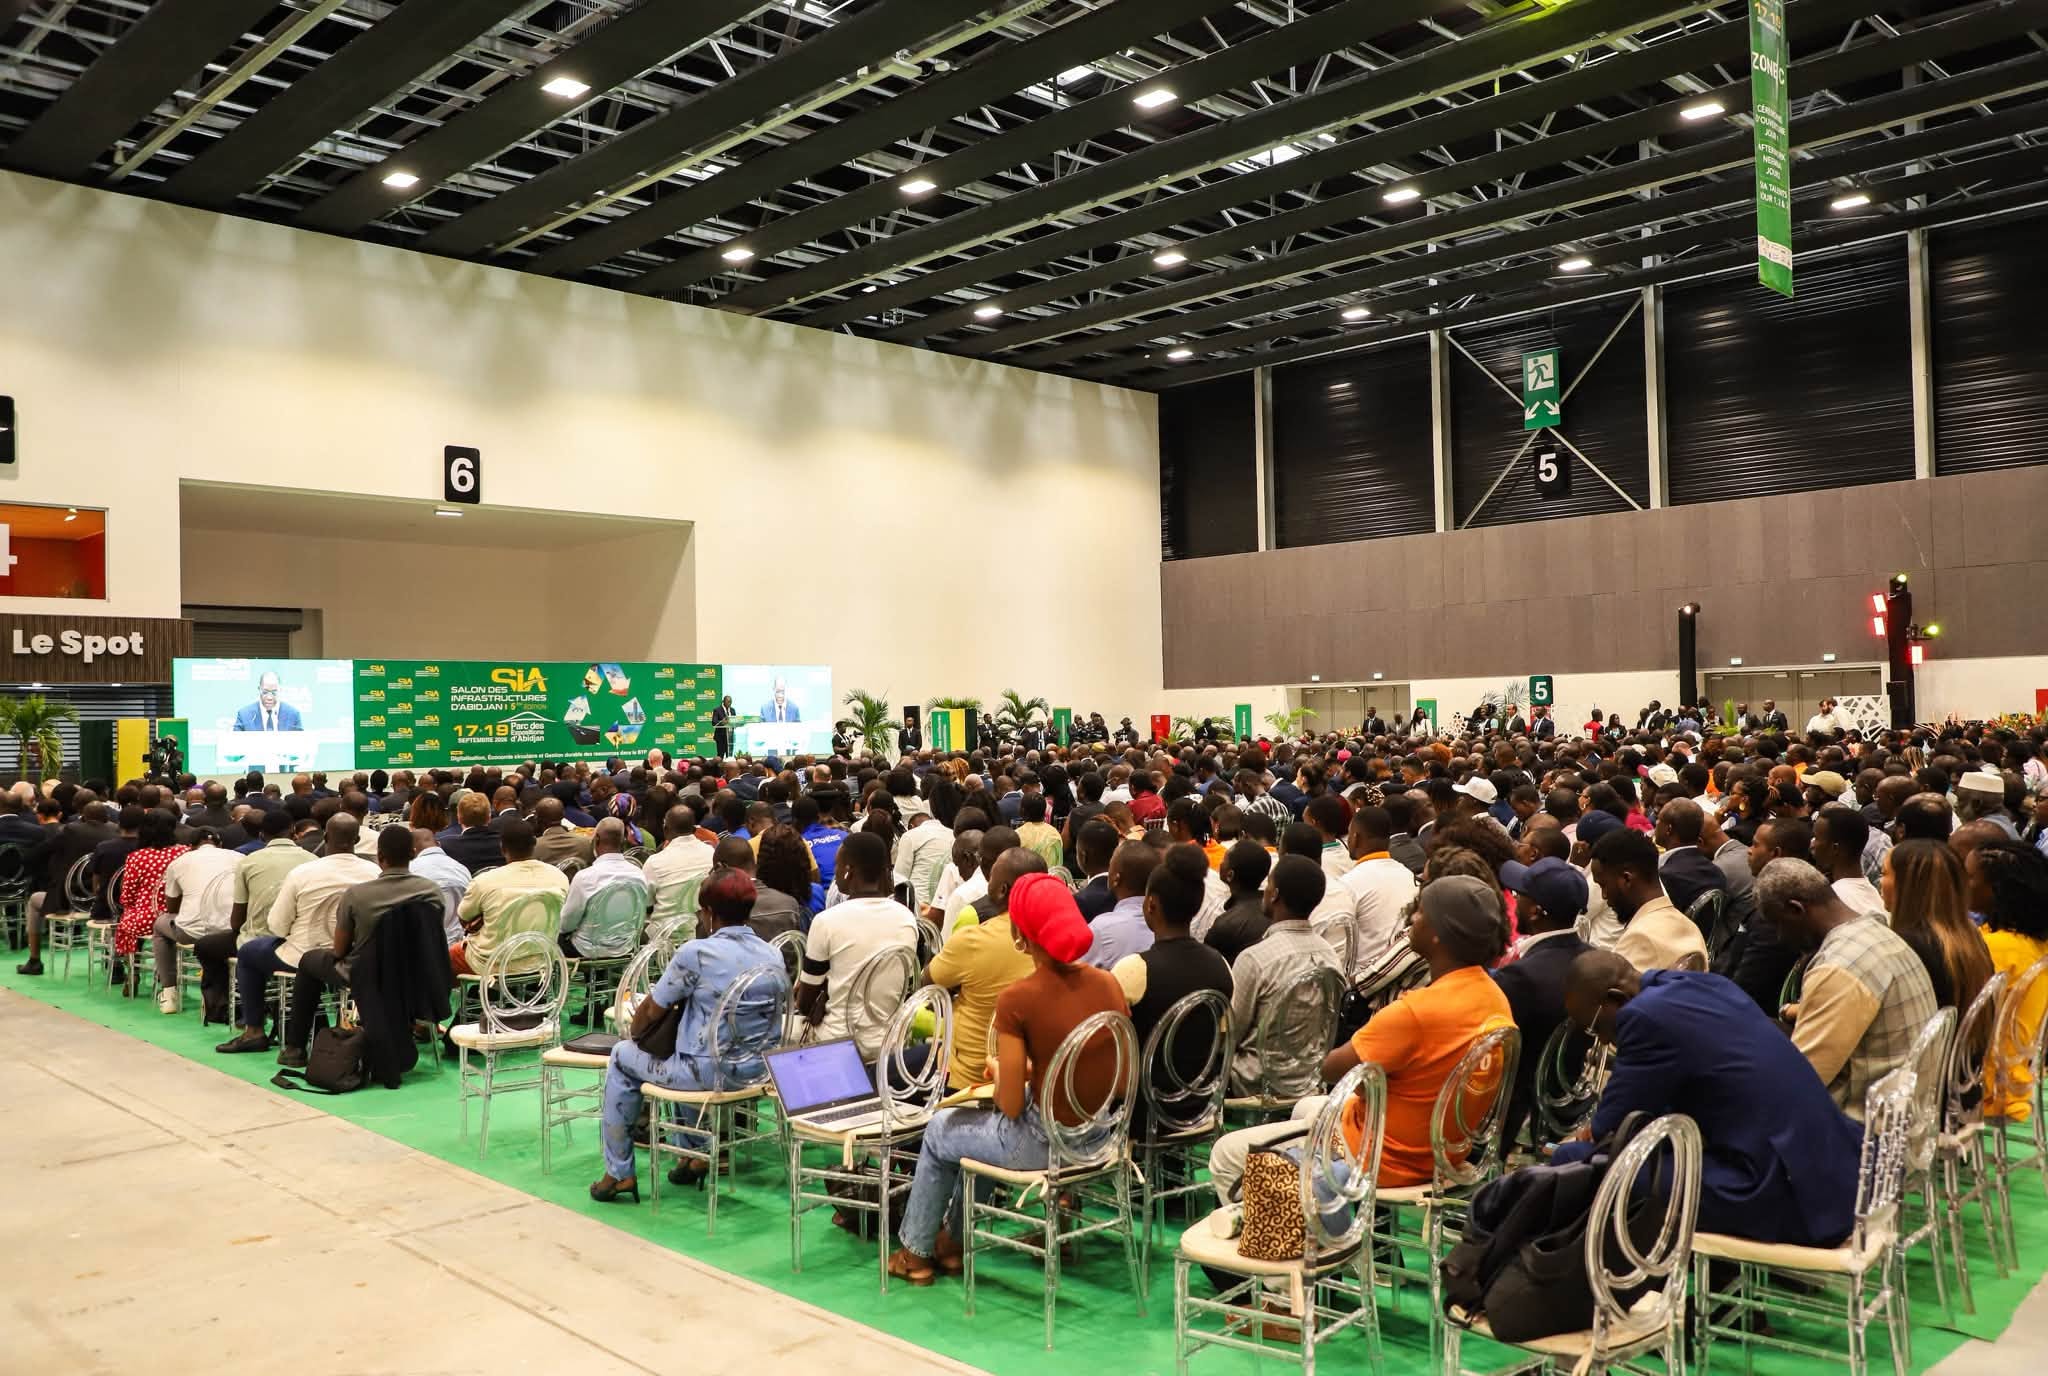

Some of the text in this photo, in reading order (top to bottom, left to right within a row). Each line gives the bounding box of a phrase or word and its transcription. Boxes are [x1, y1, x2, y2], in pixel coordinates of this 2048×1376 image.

[450, 457, 475, 493] 6
[1538, 452, 1558, 483] 5
[12, 629, 144, 664] Le Spot
[450, 686, 508, 694] SALON DES
[1534, 681, 1549, 701] 5
[450, 694, 547, 702] INFRASTRUCTURES
[450, 703, 503, 711] D'ABIDJAN
[510, 721, 545, 731] Parc des
